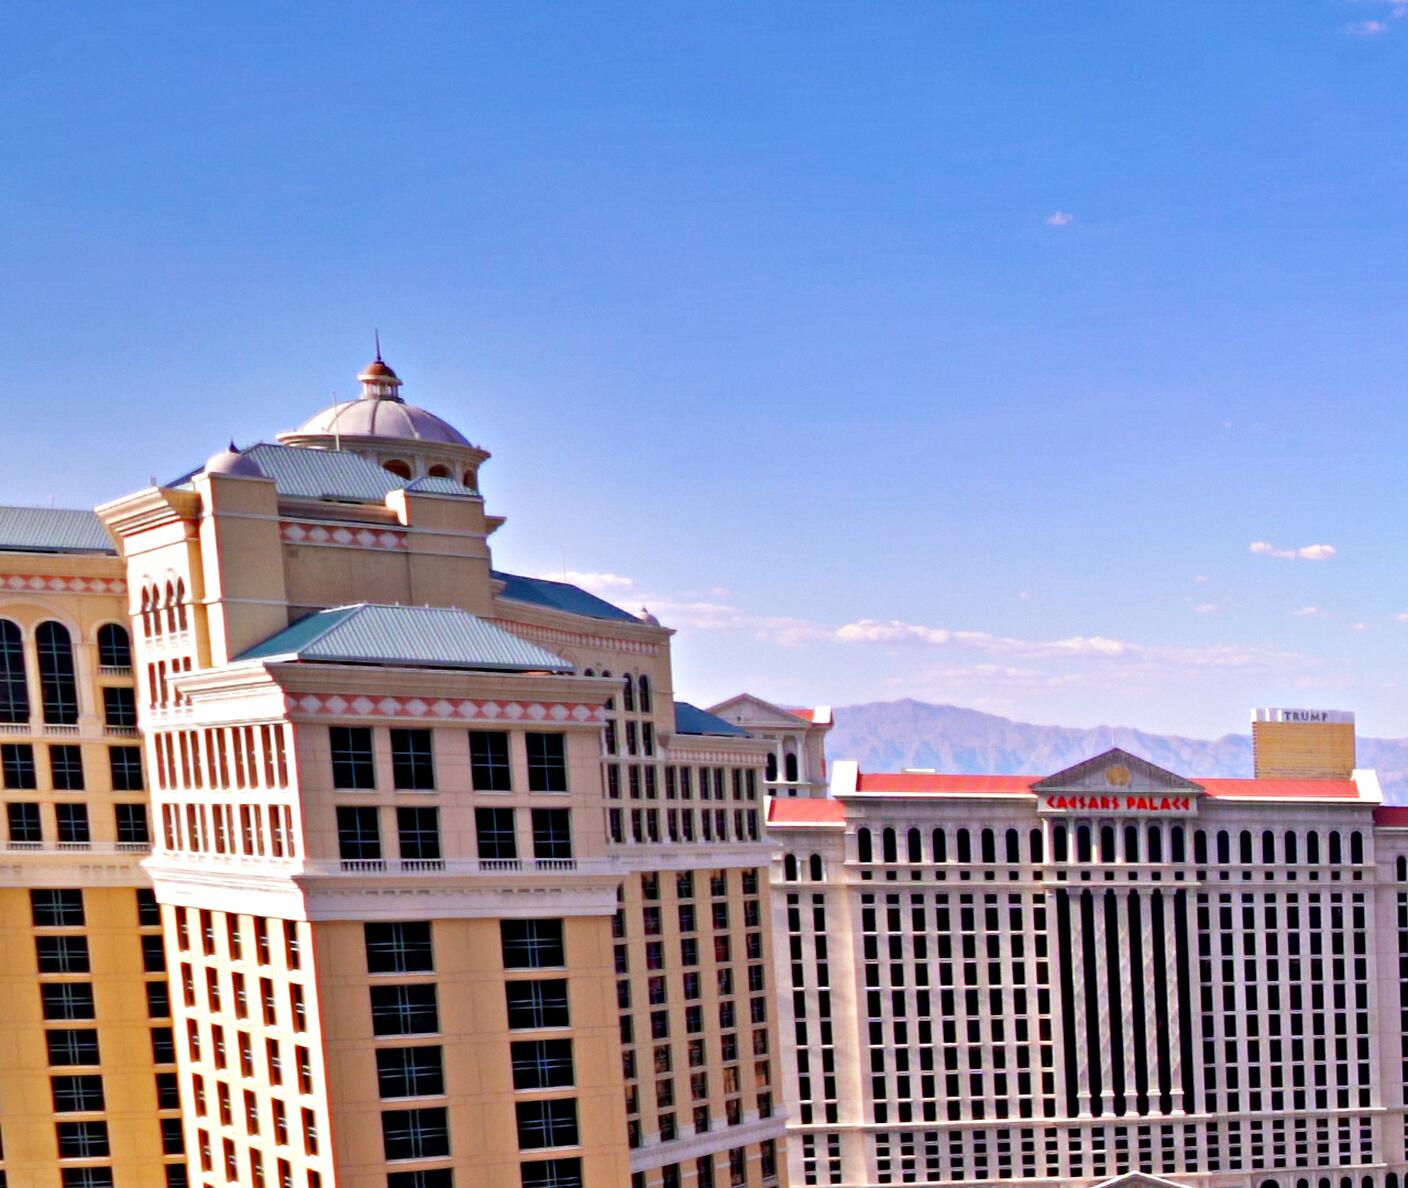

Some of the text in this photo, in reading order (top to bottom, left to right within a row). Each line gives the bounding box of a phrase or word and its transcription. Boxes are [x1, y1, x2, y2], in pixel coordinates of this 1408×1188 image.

[1284, 711, 1328, 722] TRUMP
[1046, 795, 1190, 811] CAESARS PALACE
